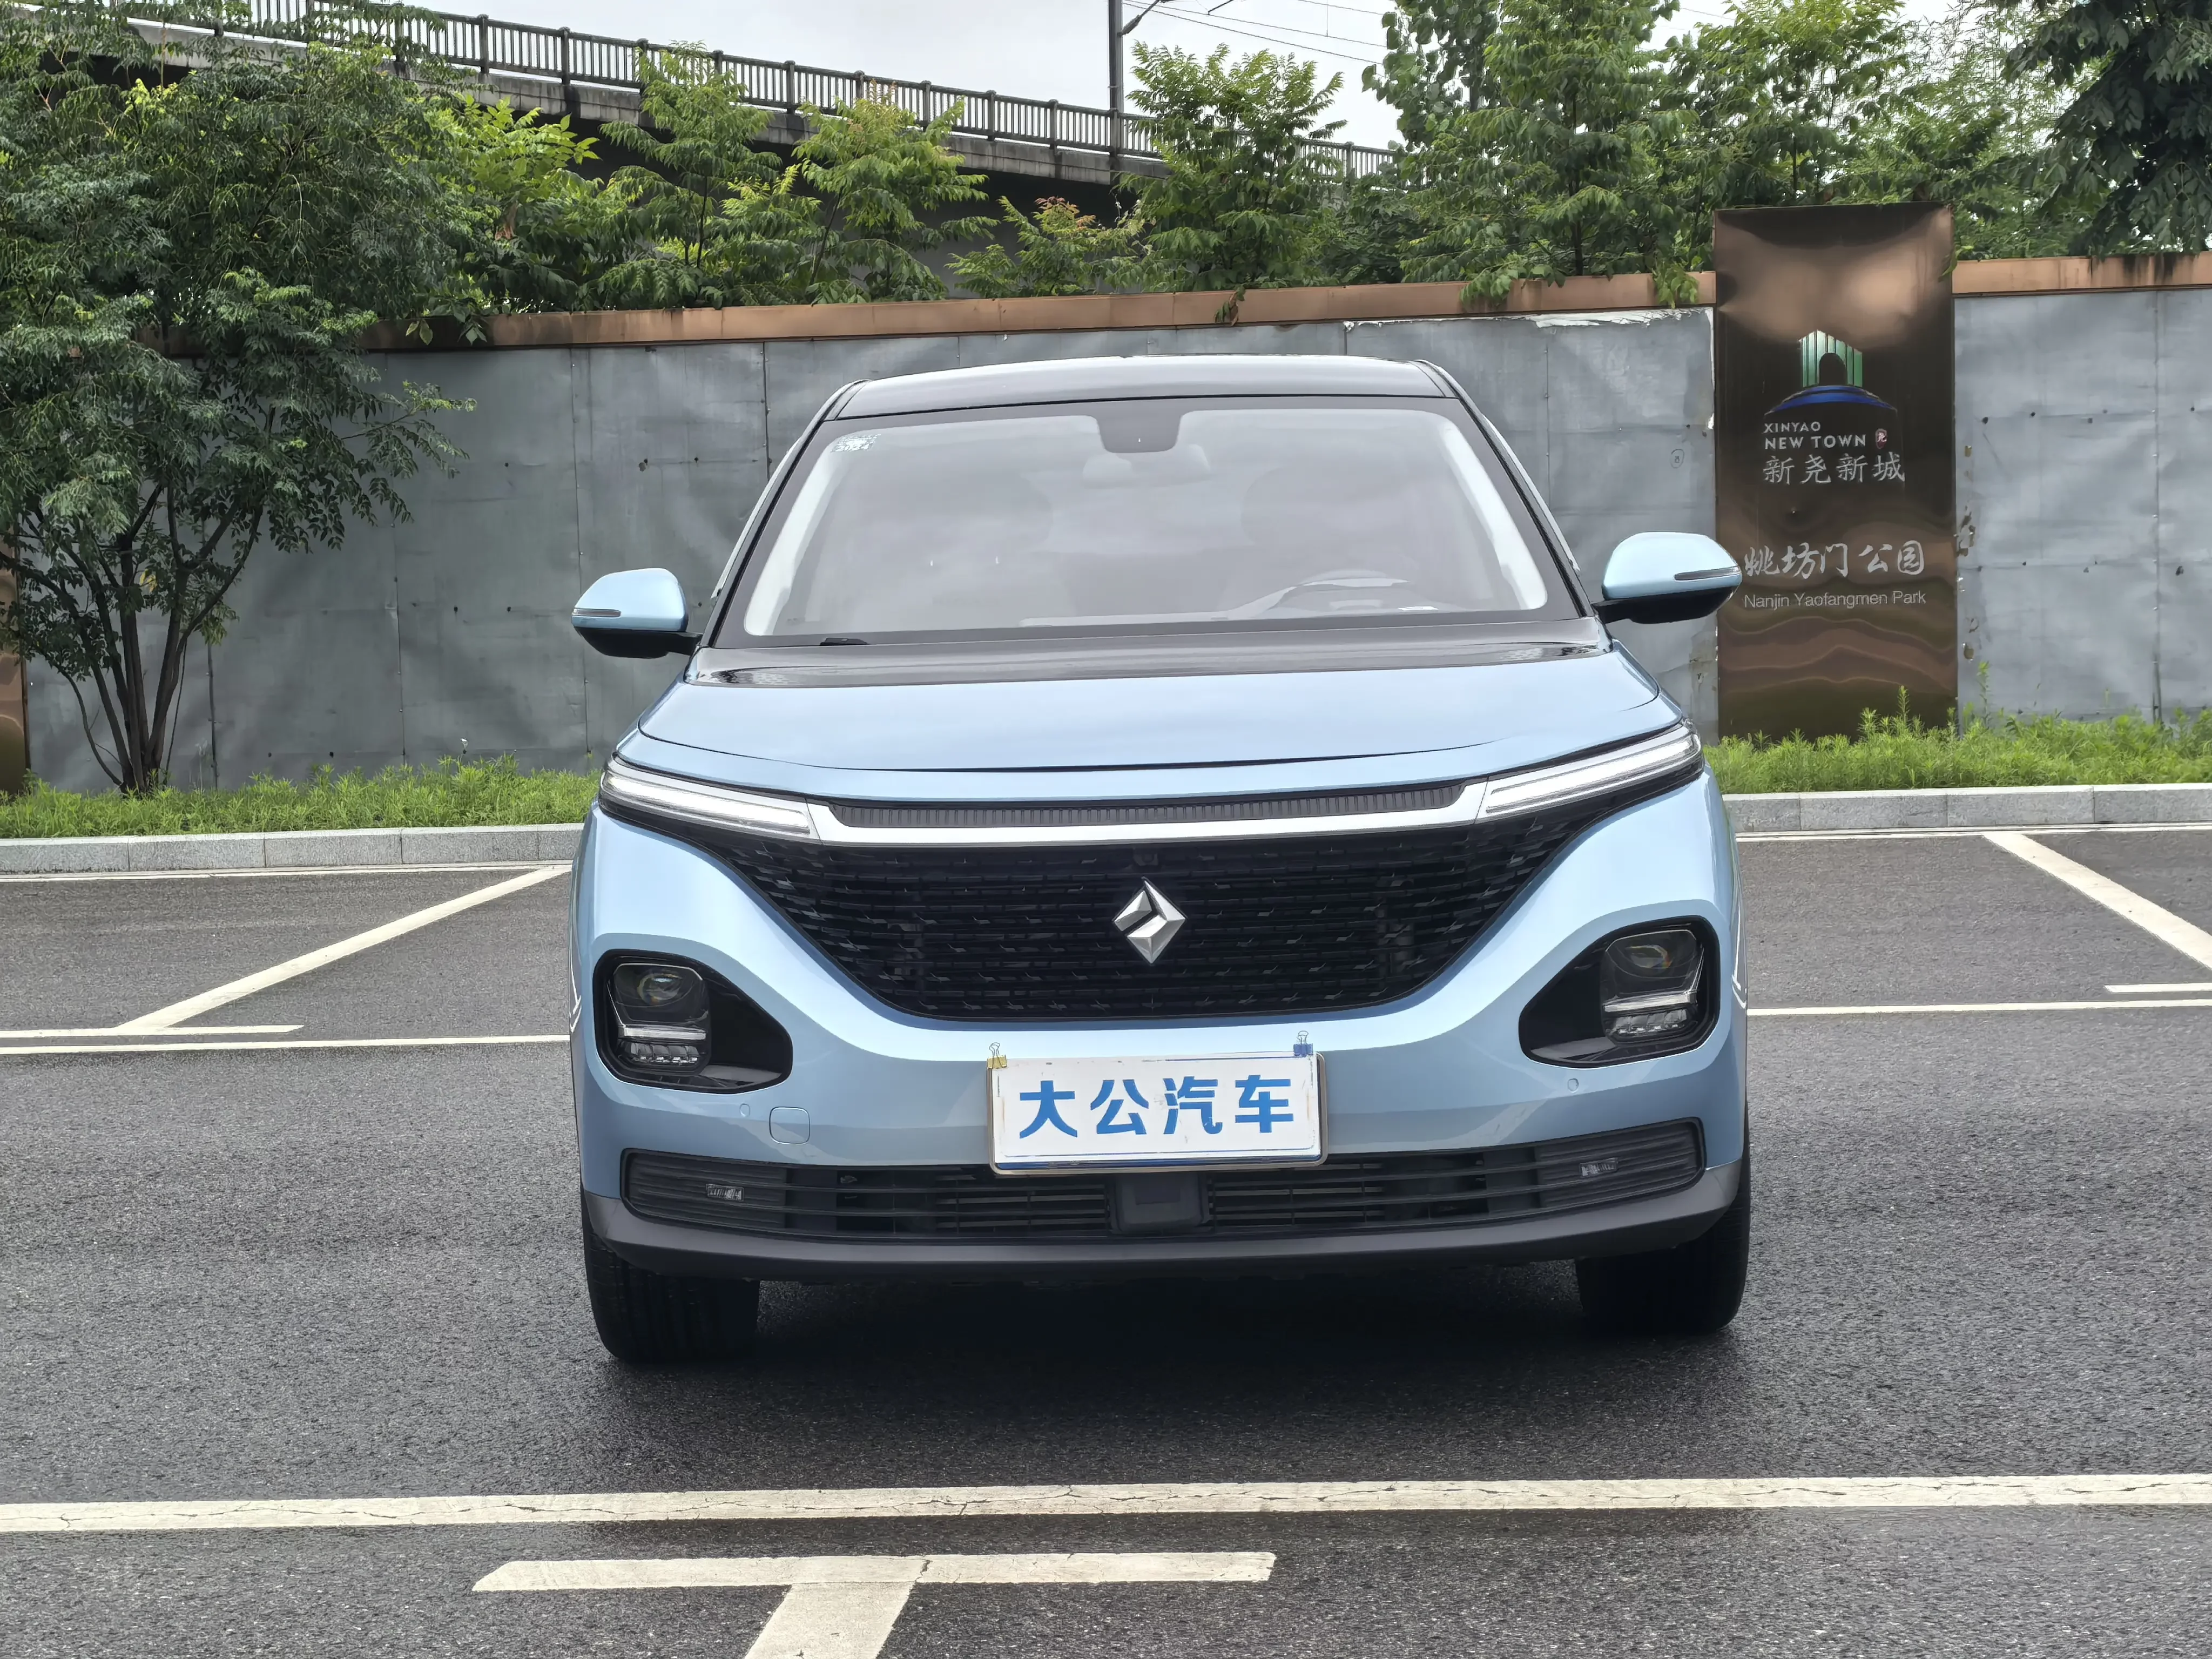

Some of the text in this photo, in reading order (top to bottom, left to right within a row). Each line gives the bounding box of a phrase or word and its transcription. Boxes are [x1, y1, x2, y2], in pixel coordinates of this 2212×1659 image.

[1762, 421, 1821, 434] XINYAO
[1764, 434, 1866, 450] NEW TOWN
[1762, 451, 1905, 485] 新尧新城
[1744, 540, 1925, 580] 姚坊门公园
[1744, 594, 1790, 610] Nanjin
[1892, 590, 1926, 604] Park
[1019, 1074, 1294, 1139] 大公汽车
